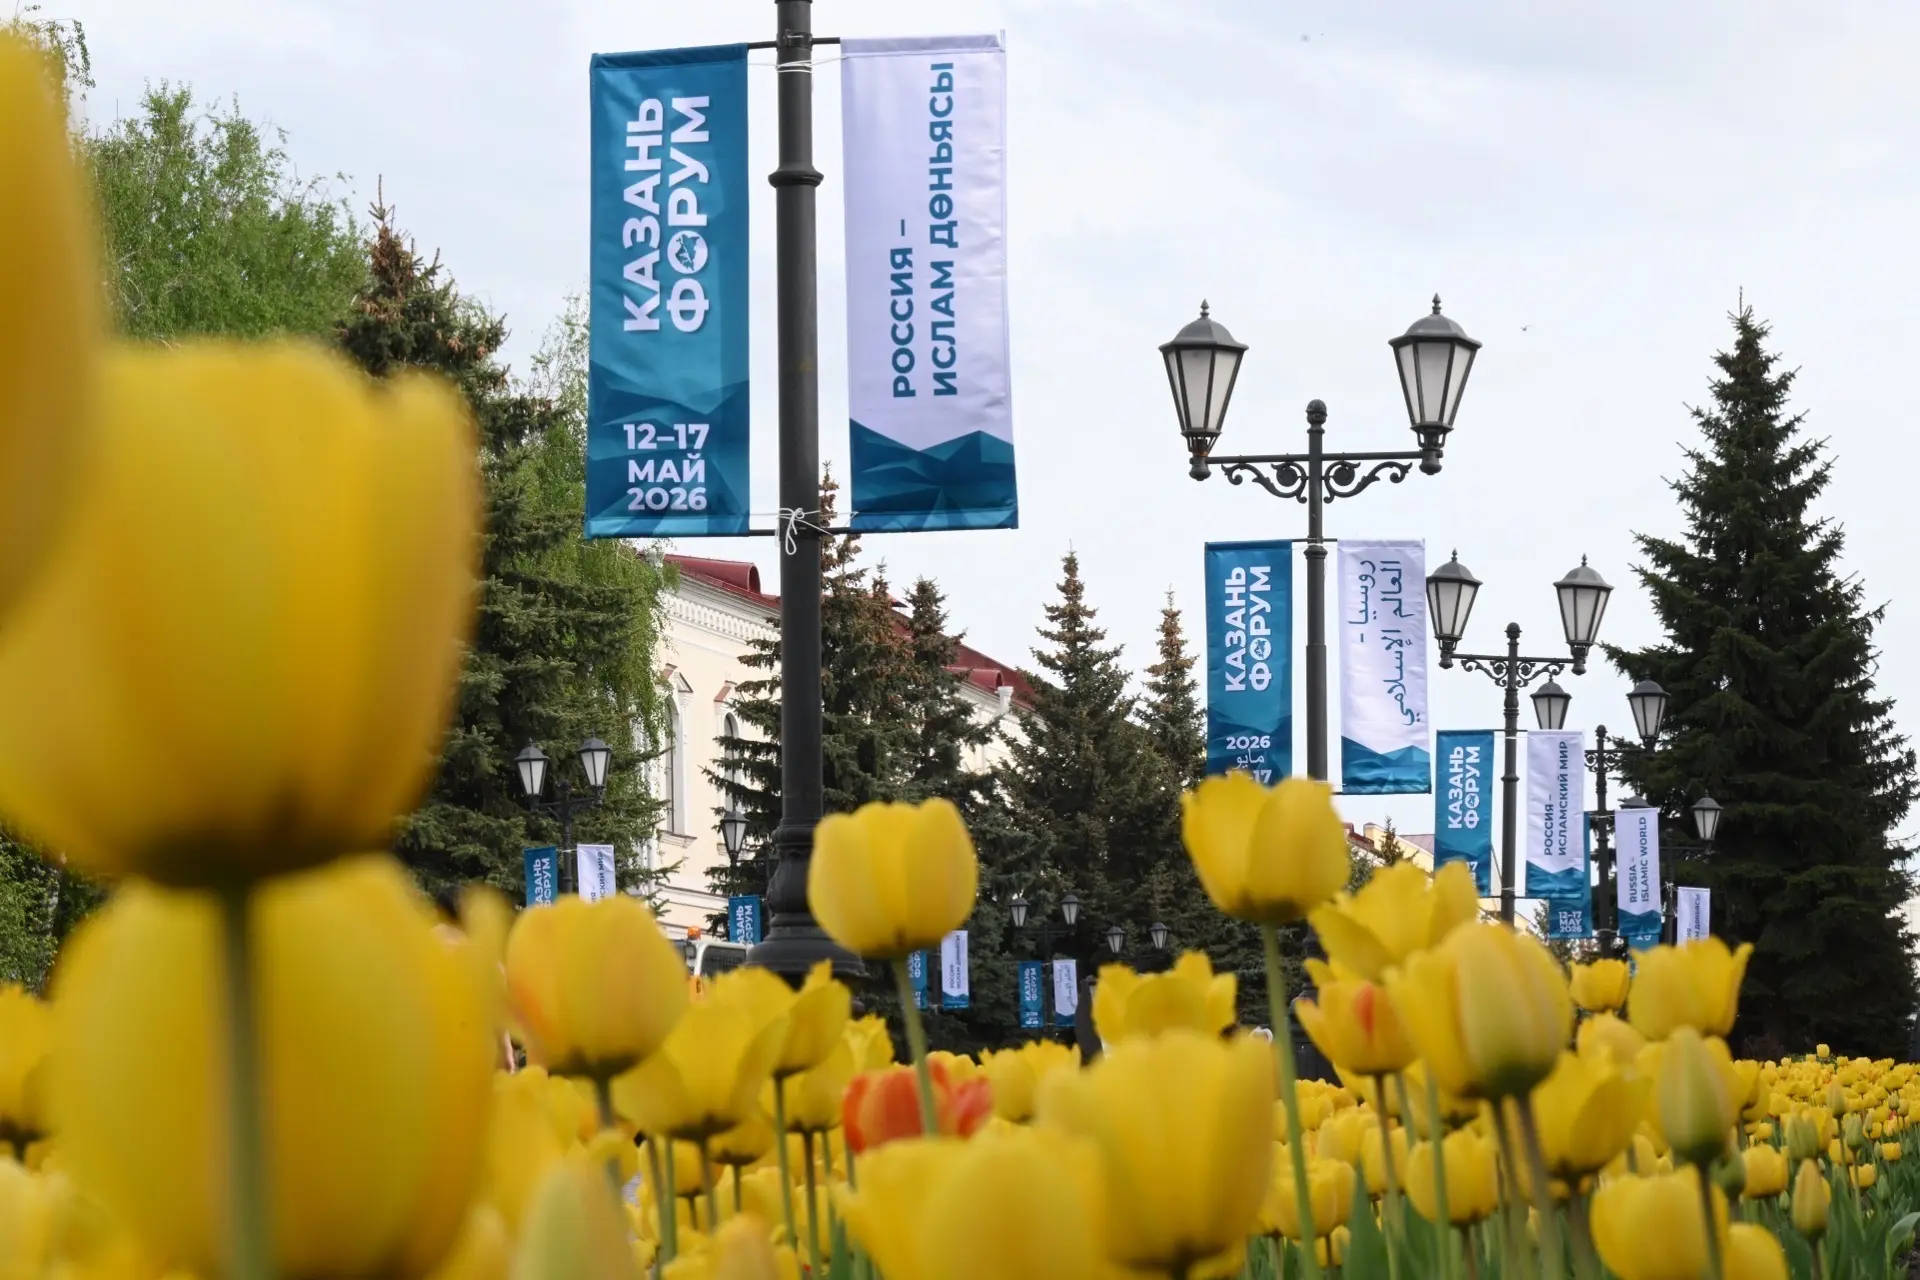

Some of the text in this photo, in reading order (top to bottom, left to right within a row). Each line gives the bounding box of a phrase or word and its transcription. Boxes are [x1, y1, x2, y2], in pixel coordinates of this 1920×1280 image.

[622, 97, 664, 332] КАЗАНЬ
[666, 95, 710, 333] ФОРУМ
[929, 62, 958, 396] ИСЛАМ ДӨНЬЯСЫ
[890, 247, 916, 397] РОССИЯ
[627, 487, 708, 512] 2026
[628, 453, 706, 483] МАЙ
[1225, 567, 1246, 692] КАЗАНЬ
[1249, 566, 1272, 691] ФОРУМ
[1348, 560, 1376, 625] روسيا
[1380, 561, 1421, 726] العالم الإسلامي
[1226, 735, 1271, 749] 2026
[1232, 748, 1265, 769] مايو
[1448, 746, 1464, 829] КАЗАНЬ
[1464, 746, 1481, 829] ФОРУМ
[1558, 741, 1569, 856] ИСЛАМСКИЙ МИР
[1544, 804, 1554, 856] РОССИЯ
[1639, 817, 1650, 902] ISLAMIC WORLD
[736, 905, 745, 945] АЗАНЬ
[1629, 864, 1638, 903] RUSSIA
